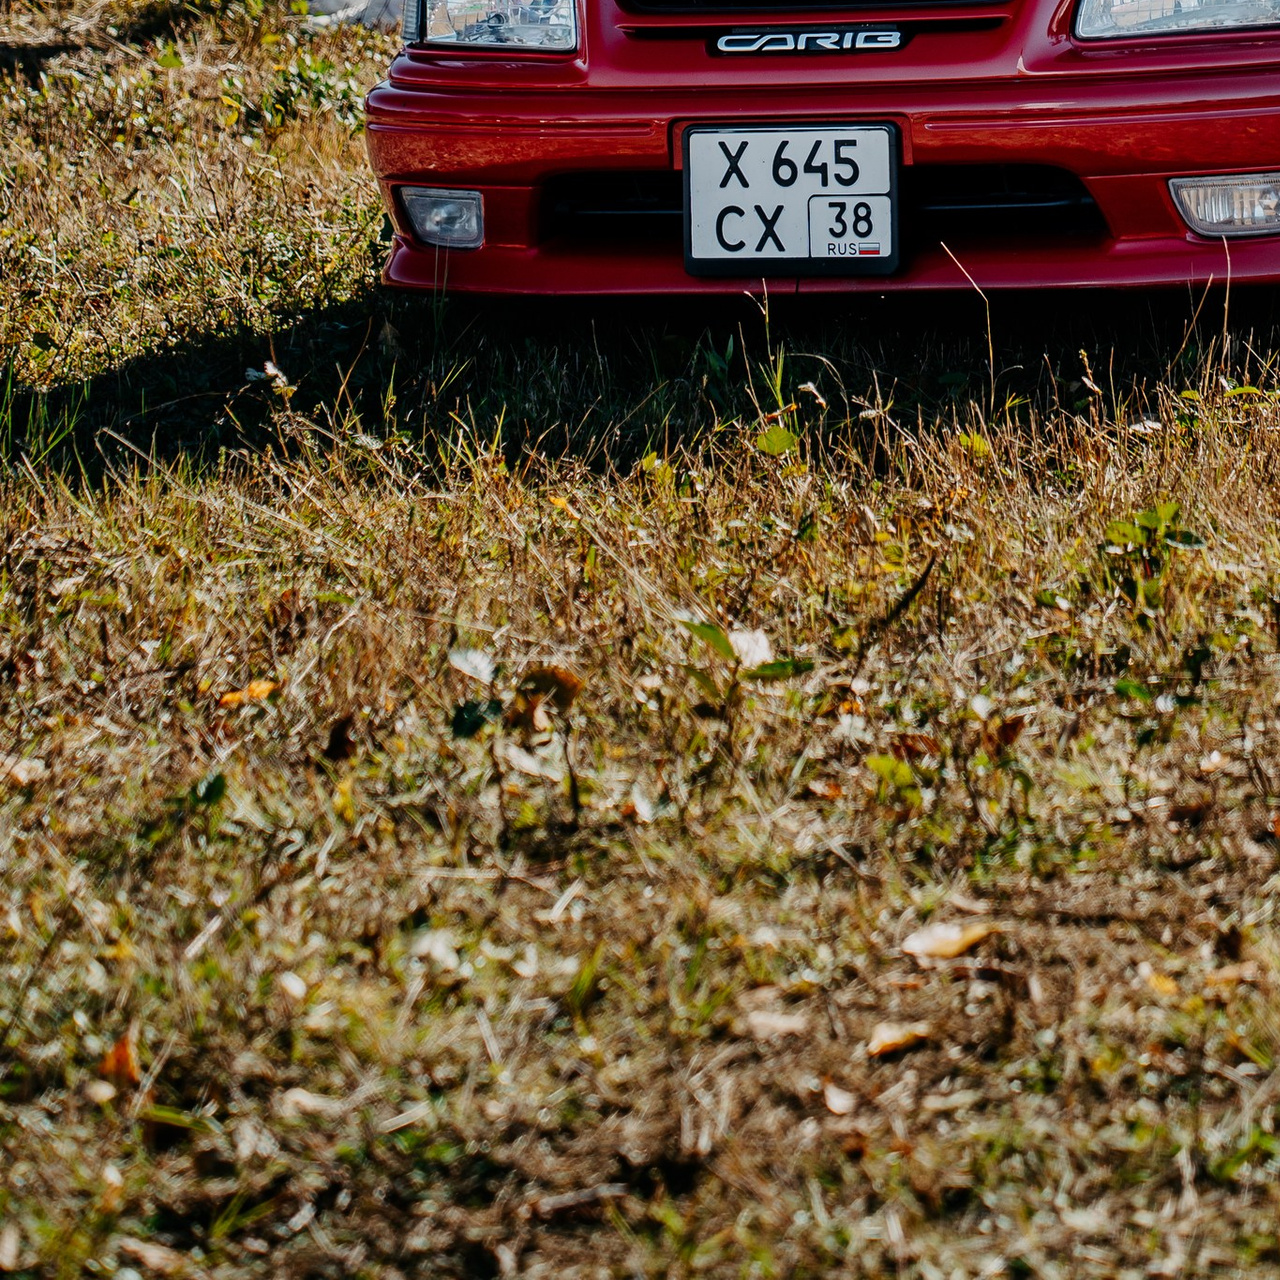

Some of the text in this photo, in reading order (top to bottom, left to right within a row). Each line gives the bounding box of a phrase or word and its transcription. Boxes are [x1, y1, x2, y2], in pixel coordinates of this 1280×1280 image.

[717, 32, 901, 51] CARIB
[772, 139, 859, 187] 645
[828, 202, 873, 238] 38
[827, 242, 857, 256] RUS
